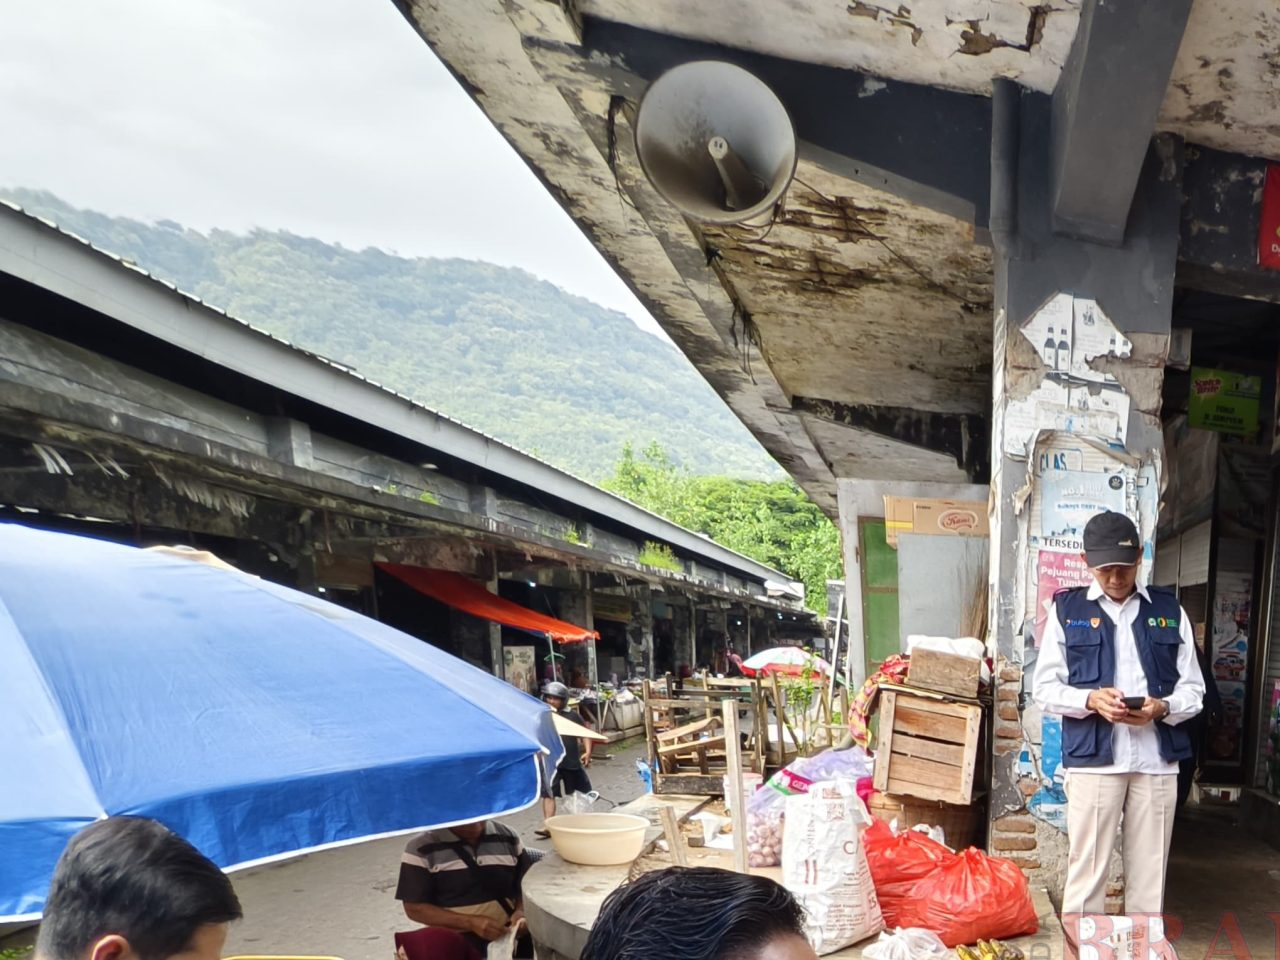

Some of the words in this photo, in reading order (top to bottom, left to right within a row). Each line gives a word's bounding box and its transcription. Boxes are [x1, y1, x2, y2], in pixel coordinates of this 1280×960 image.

[1043, 537, 1083, 549] TERSEDI
[1064, 558, 1089, 570] Resp
[1040, 565, 1081, 578] Pejuang
[1082, 568, 1095, 579] Pa
